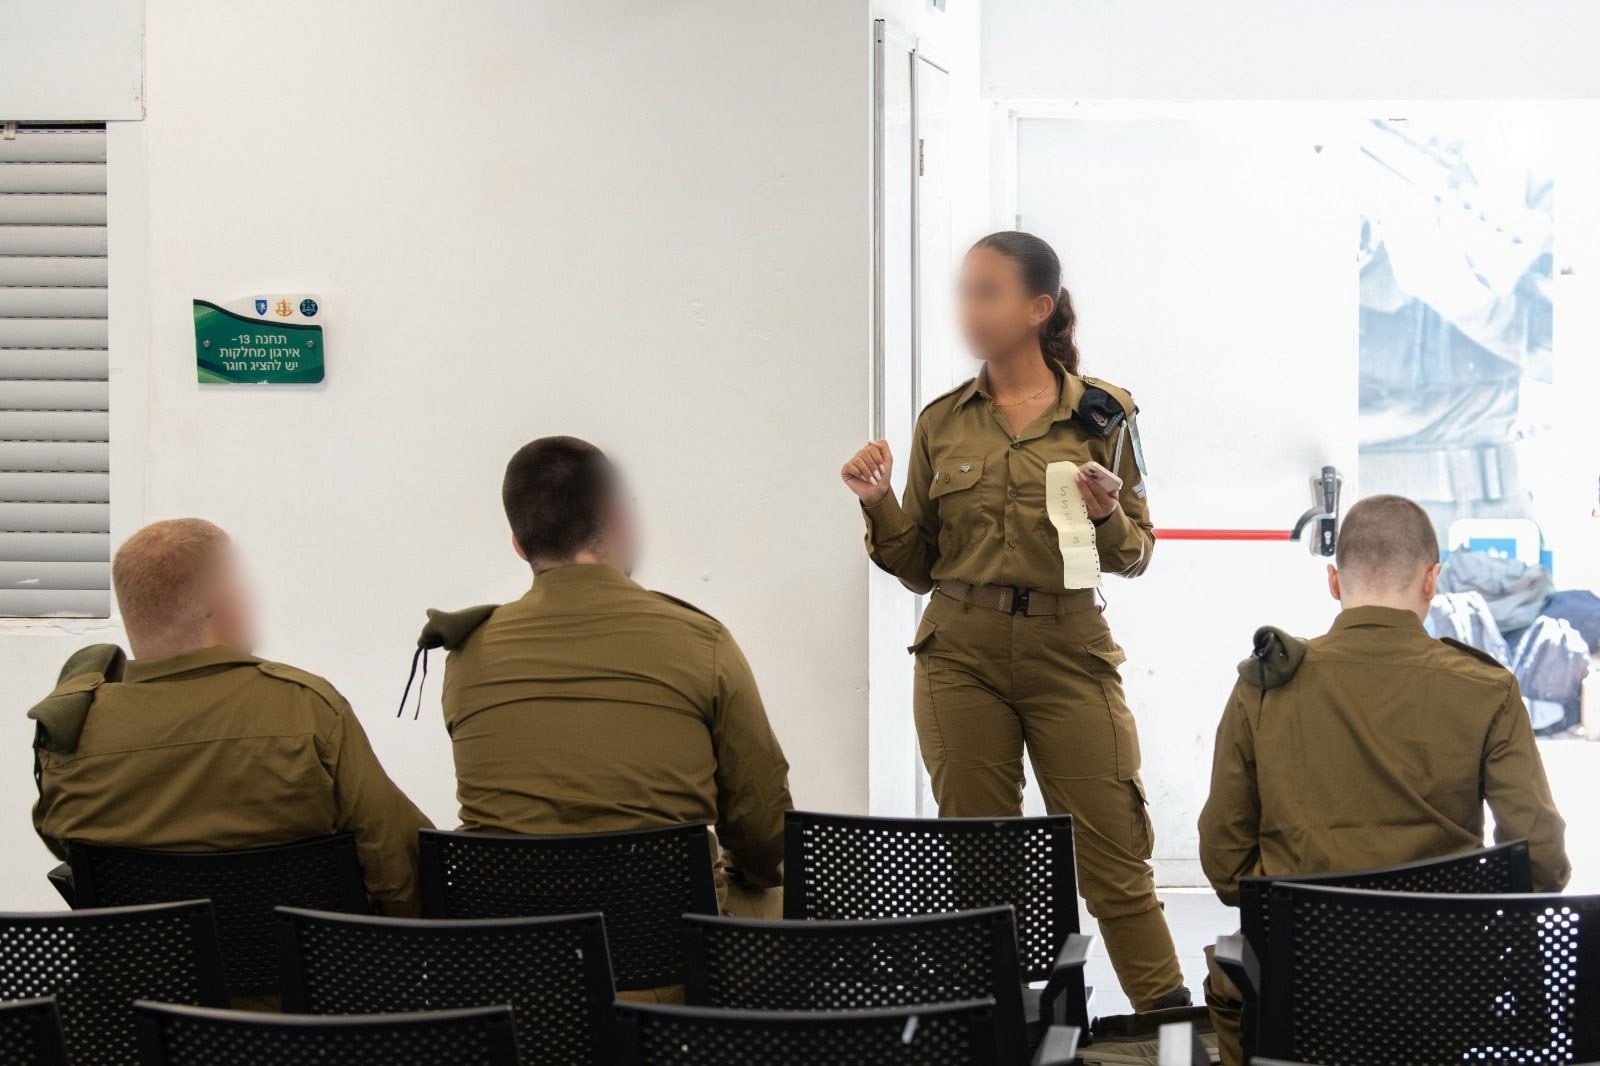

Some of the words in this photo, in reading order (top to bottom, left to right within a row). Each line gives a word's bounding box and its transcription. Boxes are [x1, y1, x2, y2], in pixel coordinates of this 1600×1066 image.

[255, 335, 287, 345] תחנה
[219, 346, 266, 360] מחלקות
[269, 348, 301, 360] אירגון
[222, 361, 248, 371] חוגר
[250, 359, 281, 371] להציג
[285, 361, 299, 371] יש
